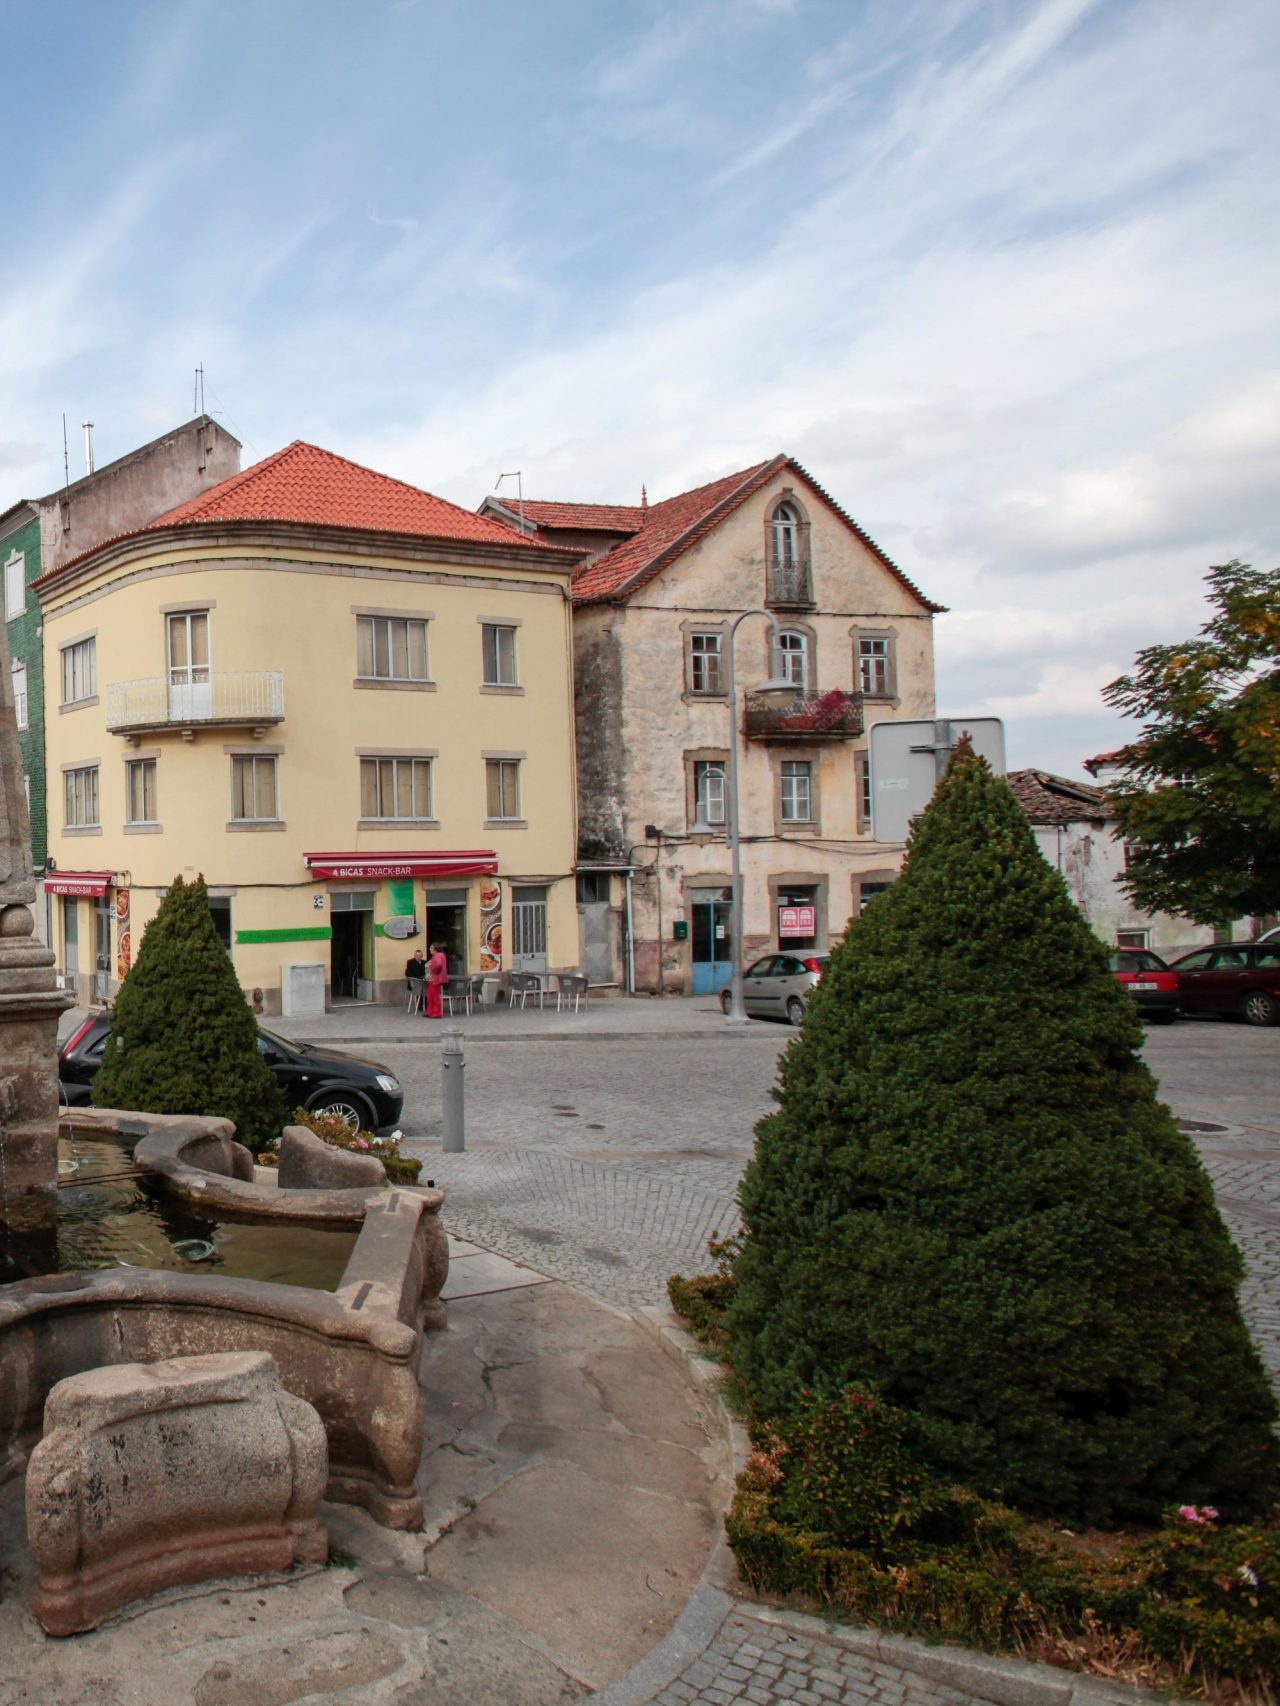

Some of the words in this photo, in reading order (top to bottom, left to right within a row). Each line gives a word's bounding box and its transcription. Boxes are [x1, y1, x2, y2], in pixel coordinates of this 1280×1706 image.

[340, 868, 364, 876] BICAS
[367, 867, 412, 876] SNACK-BAR
[68, 886, 92, 894] SNACK-BAR
